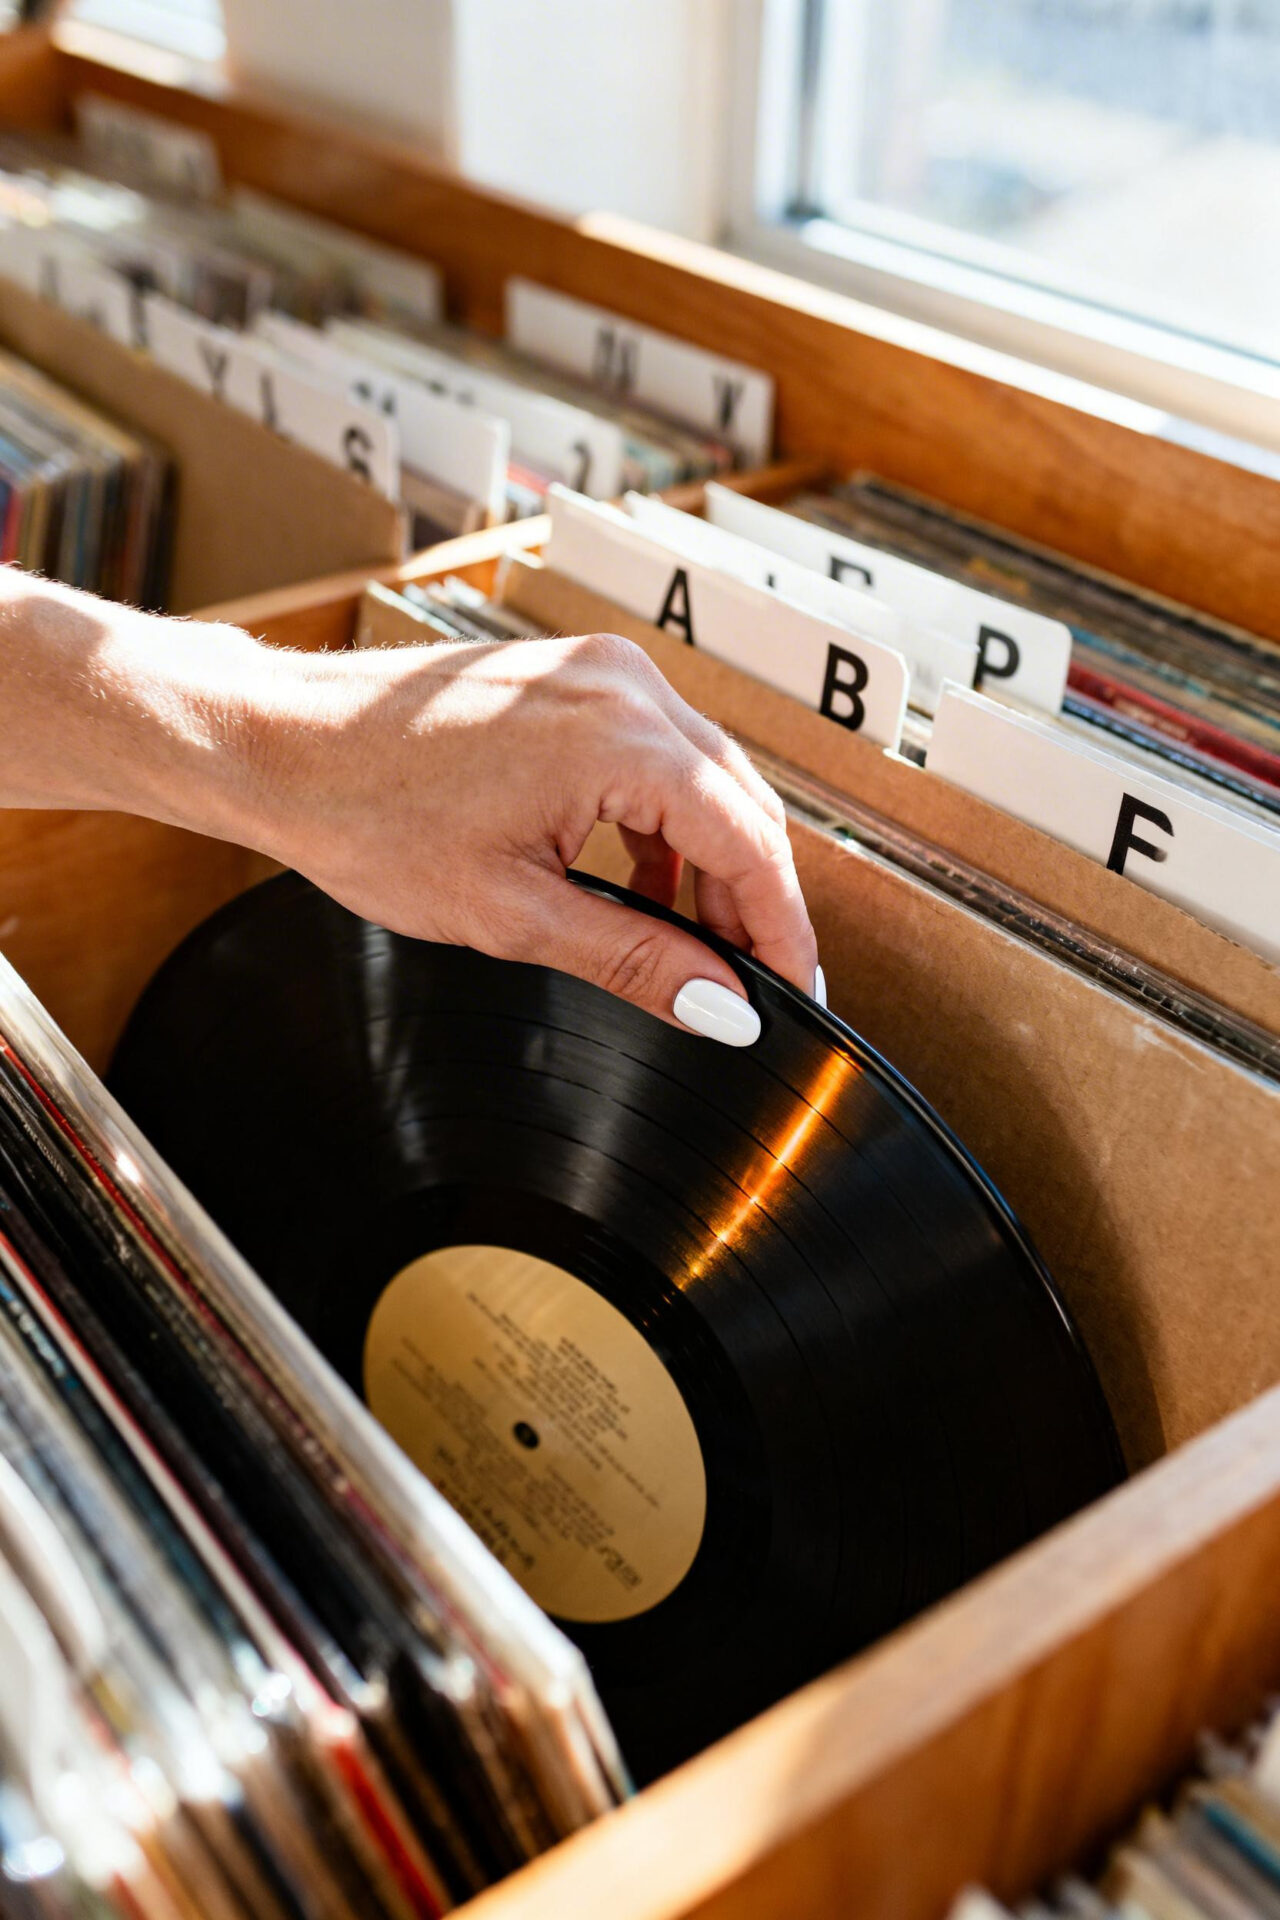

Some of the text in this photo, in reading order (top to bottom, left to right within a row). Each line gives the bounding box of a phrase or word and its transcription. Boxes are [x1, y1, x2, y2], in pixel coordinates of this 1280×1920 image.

[657, 567, 868, 731] A B
[972, 623, 1020, 690] P
